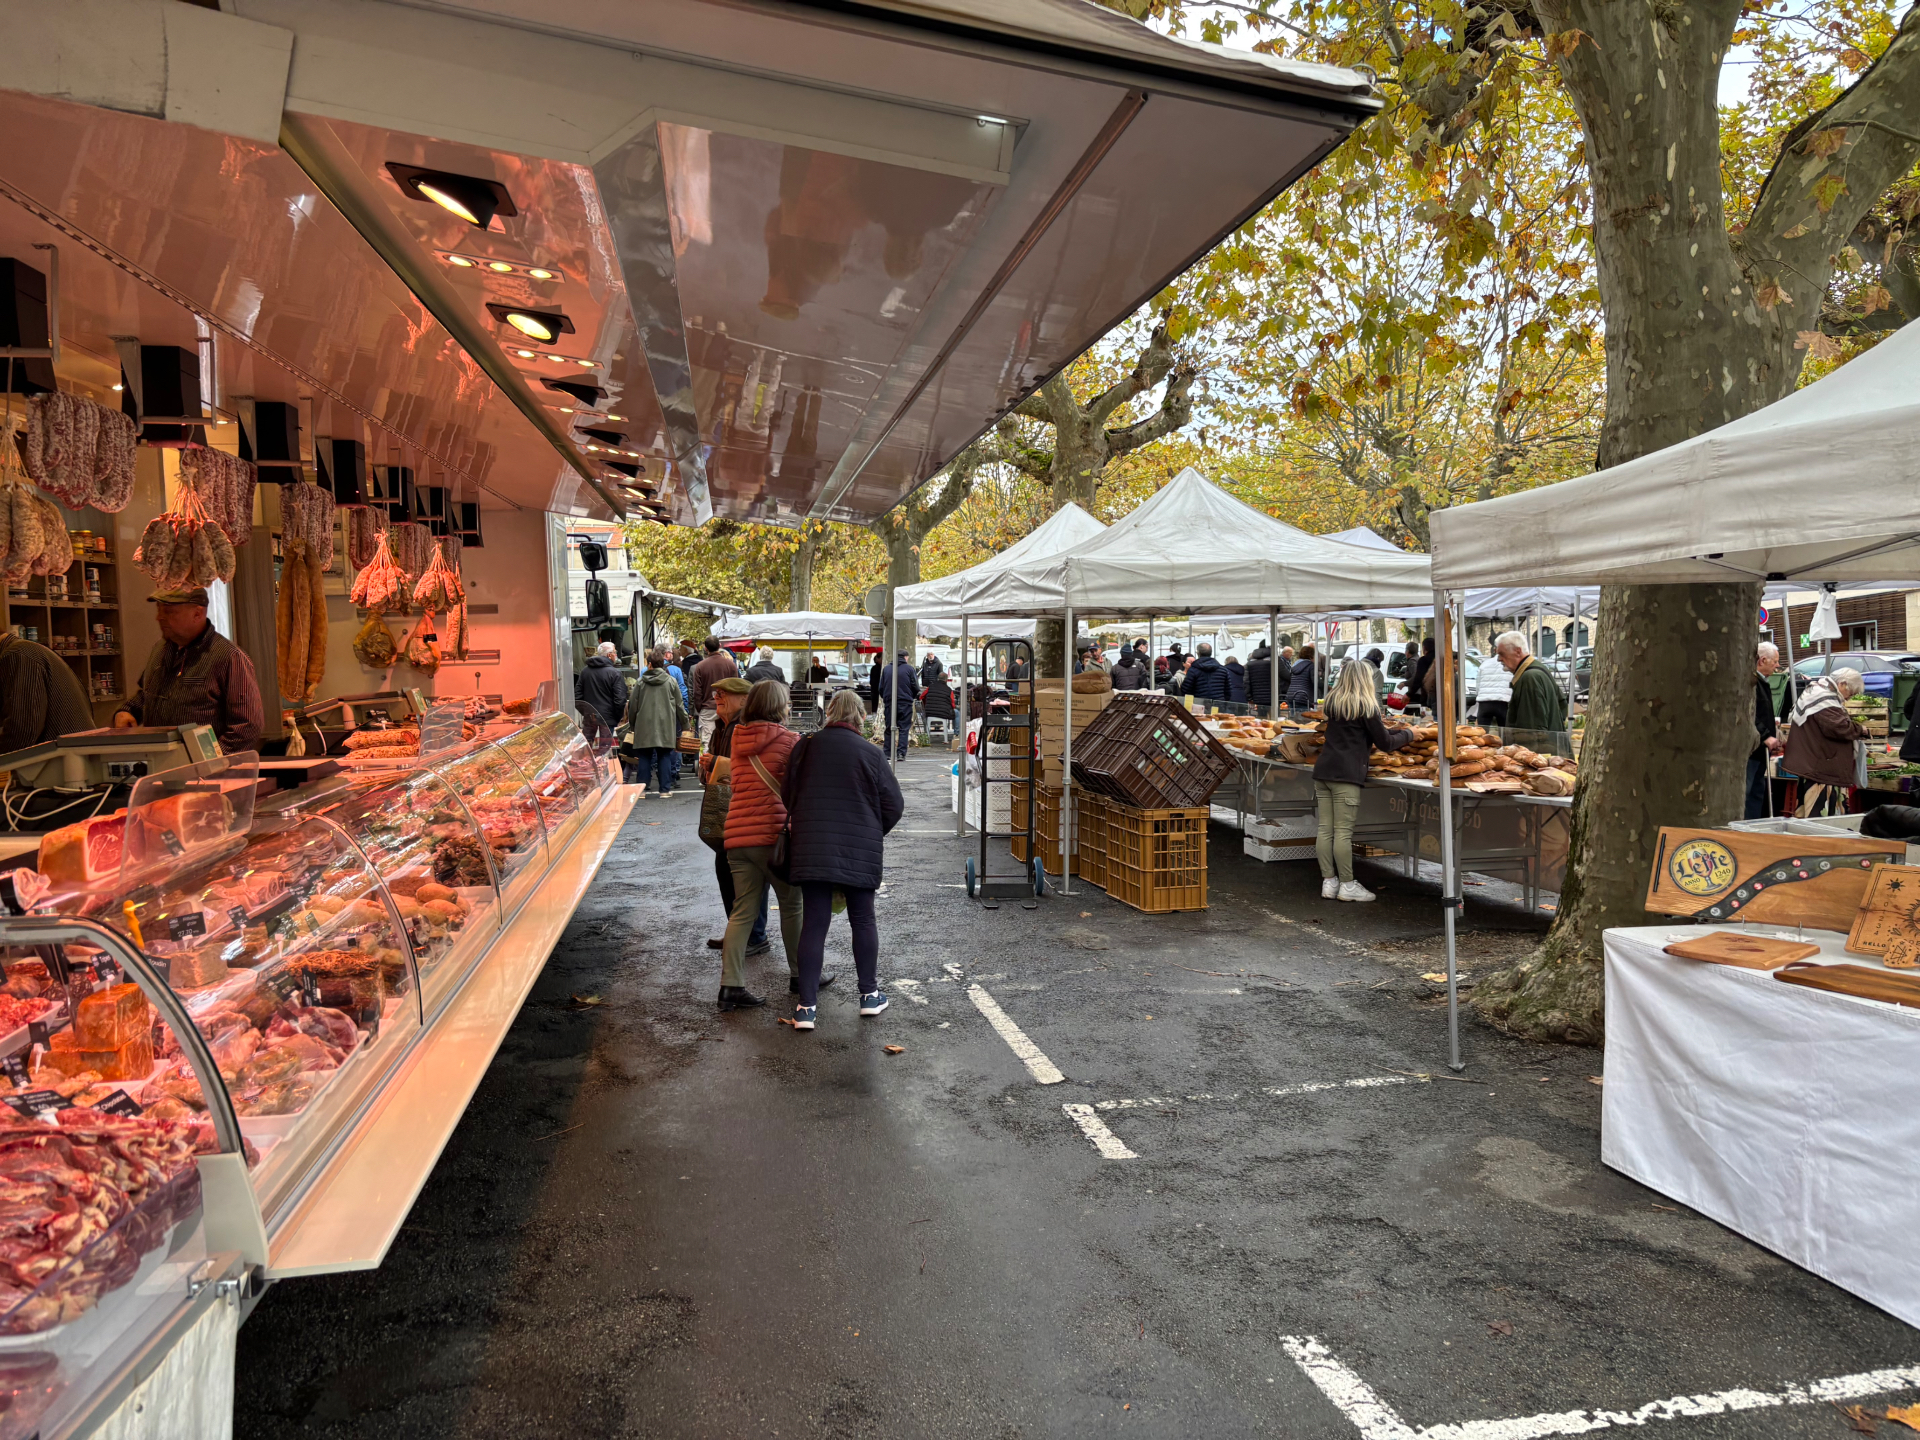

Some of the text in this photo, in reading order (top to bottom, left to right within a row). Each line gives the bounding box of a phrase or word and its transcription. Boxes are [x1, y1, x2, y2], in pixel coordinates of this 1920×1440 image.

[1676, 850, 1730, 882] Leffe
[1714, 868, 1731, 878] 1240
[1684, 877, 1701, 887] ANNO
